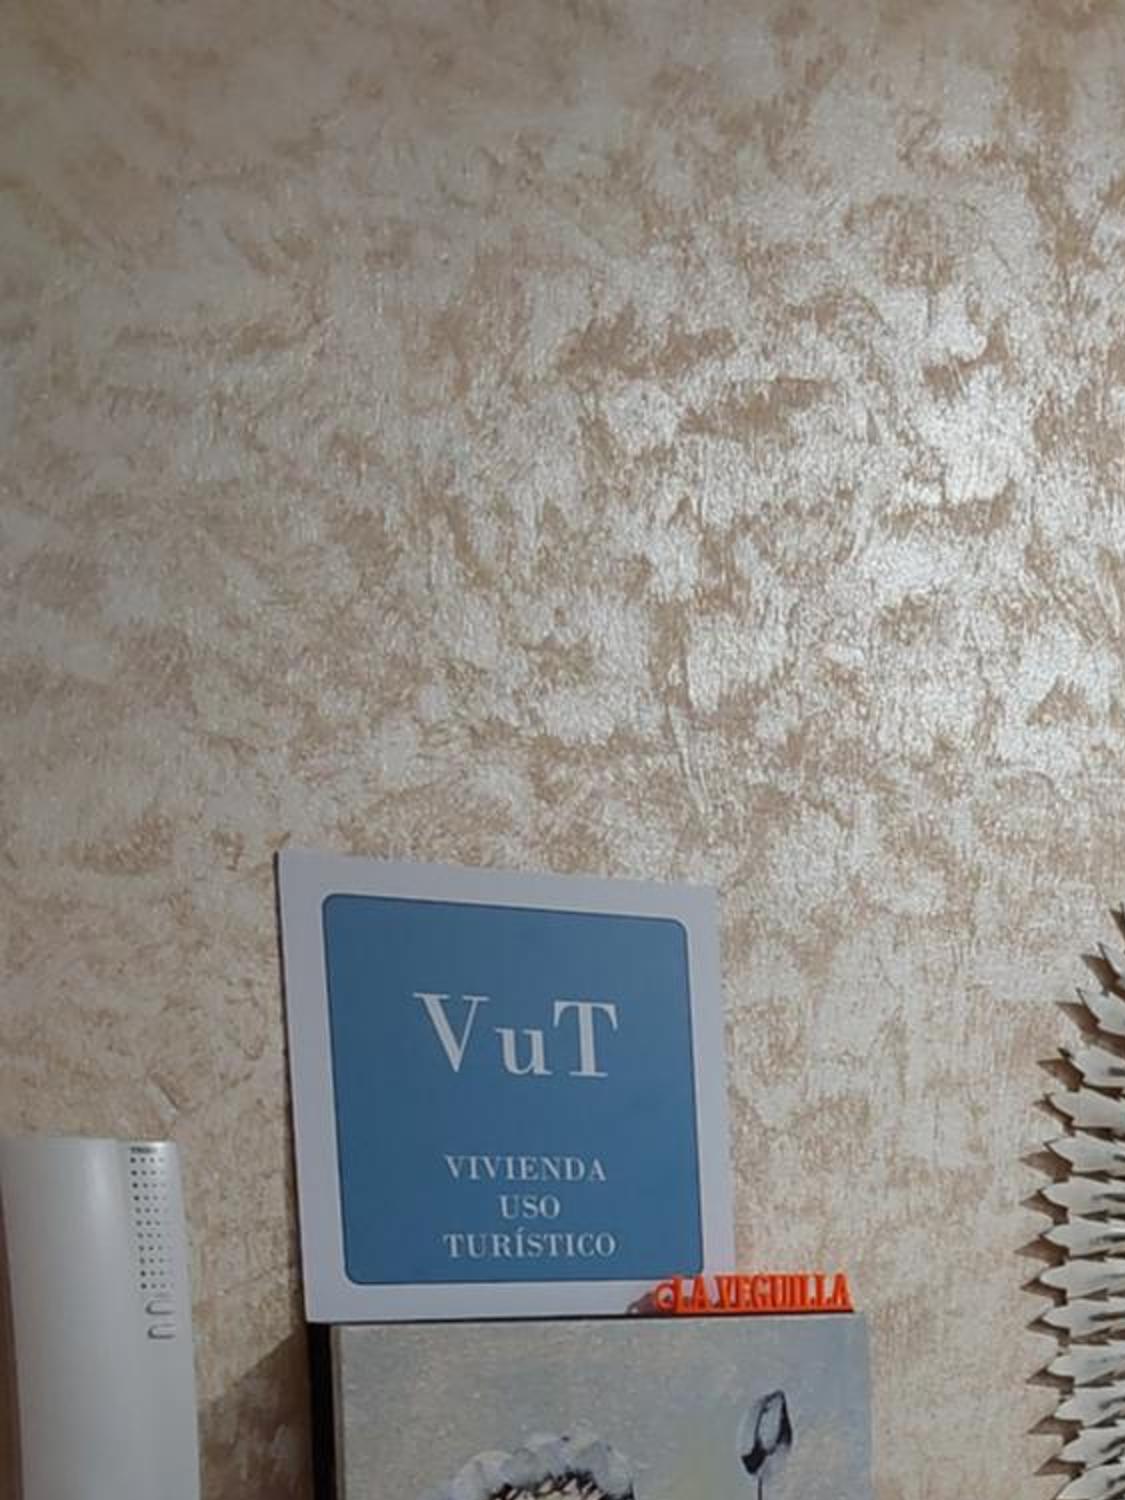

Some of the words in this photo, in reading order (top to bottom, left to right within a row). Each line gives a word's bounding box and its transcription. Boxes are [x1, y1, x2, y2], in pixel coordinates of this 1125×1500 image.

[412, 991, 618, 1078] VuT
[444, 1154, 607, 1182] VIVIENDA
[499, 1194, 561, 1220] USO
[442, 1226, 617, 1259] TURÍSTICO
